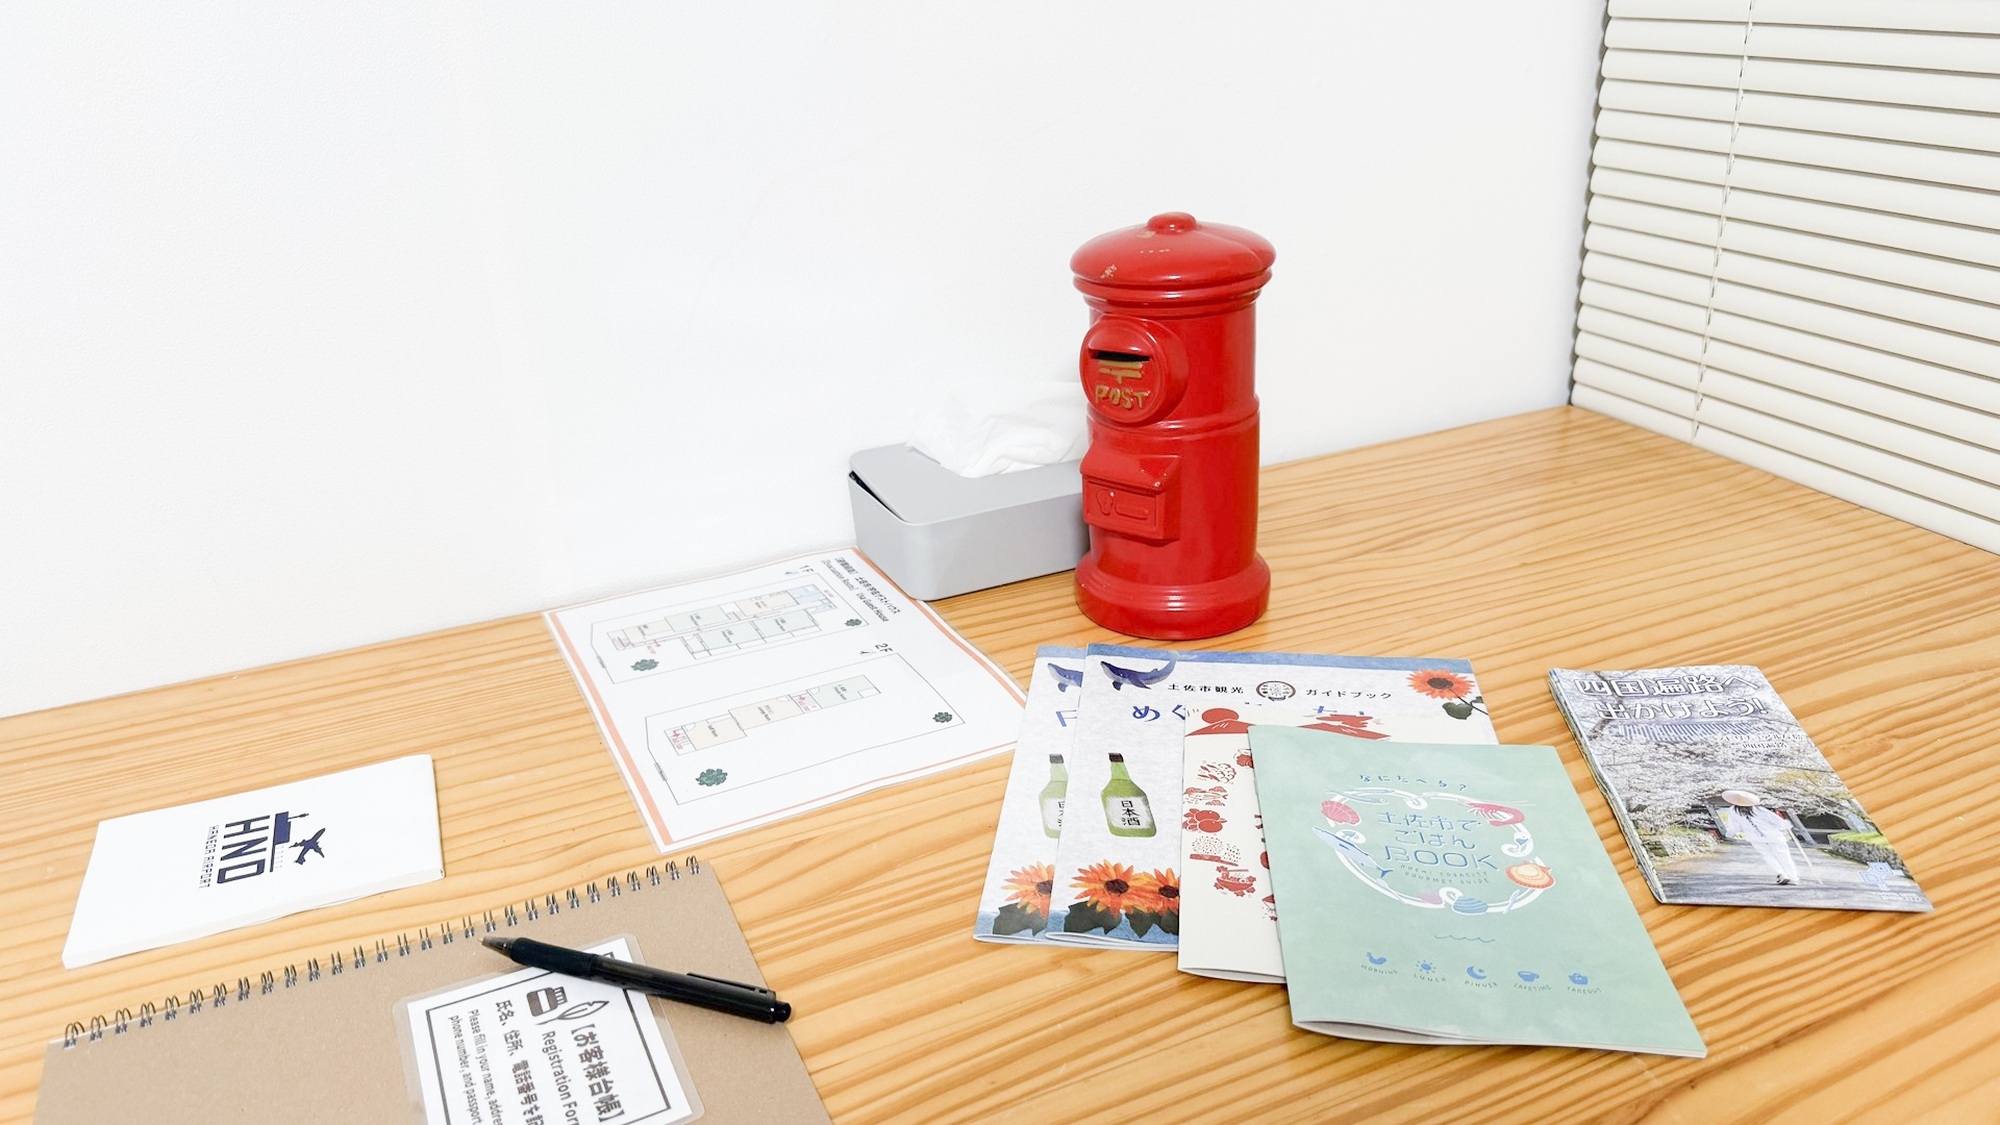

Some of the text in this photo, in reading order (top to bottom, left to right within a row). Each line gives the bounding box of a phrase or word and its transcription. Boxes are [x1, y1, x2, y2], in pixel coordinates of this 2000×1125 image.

[1095, 384, 1150, 409] POST
[799, 564, 814, 574] 1F
[875, 643, 893, 653] 2F
[1168, 683, 1245, 695] 土佐市観光
[1306, 688, 1393, 700] ガイドブック
[1574, 674, 1760, 698] 四国遍路へ
[1121, 800, 1141, 826] 日本酒
[1378, 811, 1482, 832] 土佐市で
[217, 814, 270, 884] HND
[1395, 829, 1476, 850] ごはん
[199, 824, 219, 889] HANEDA AIRPORT
[1384, 845, 1499, 871] BOOK
[448, 1015, 463, 1039] phone
[455, 1038, 471, 1073] number,
[468, 1009, 504, 1125] Please fill in your name, addre
[462, 1072, 477, 1088] and
[542, 1030, 581, 1125] Registration For
[571, 1023, 625, 1123] 【お客様台帳】
